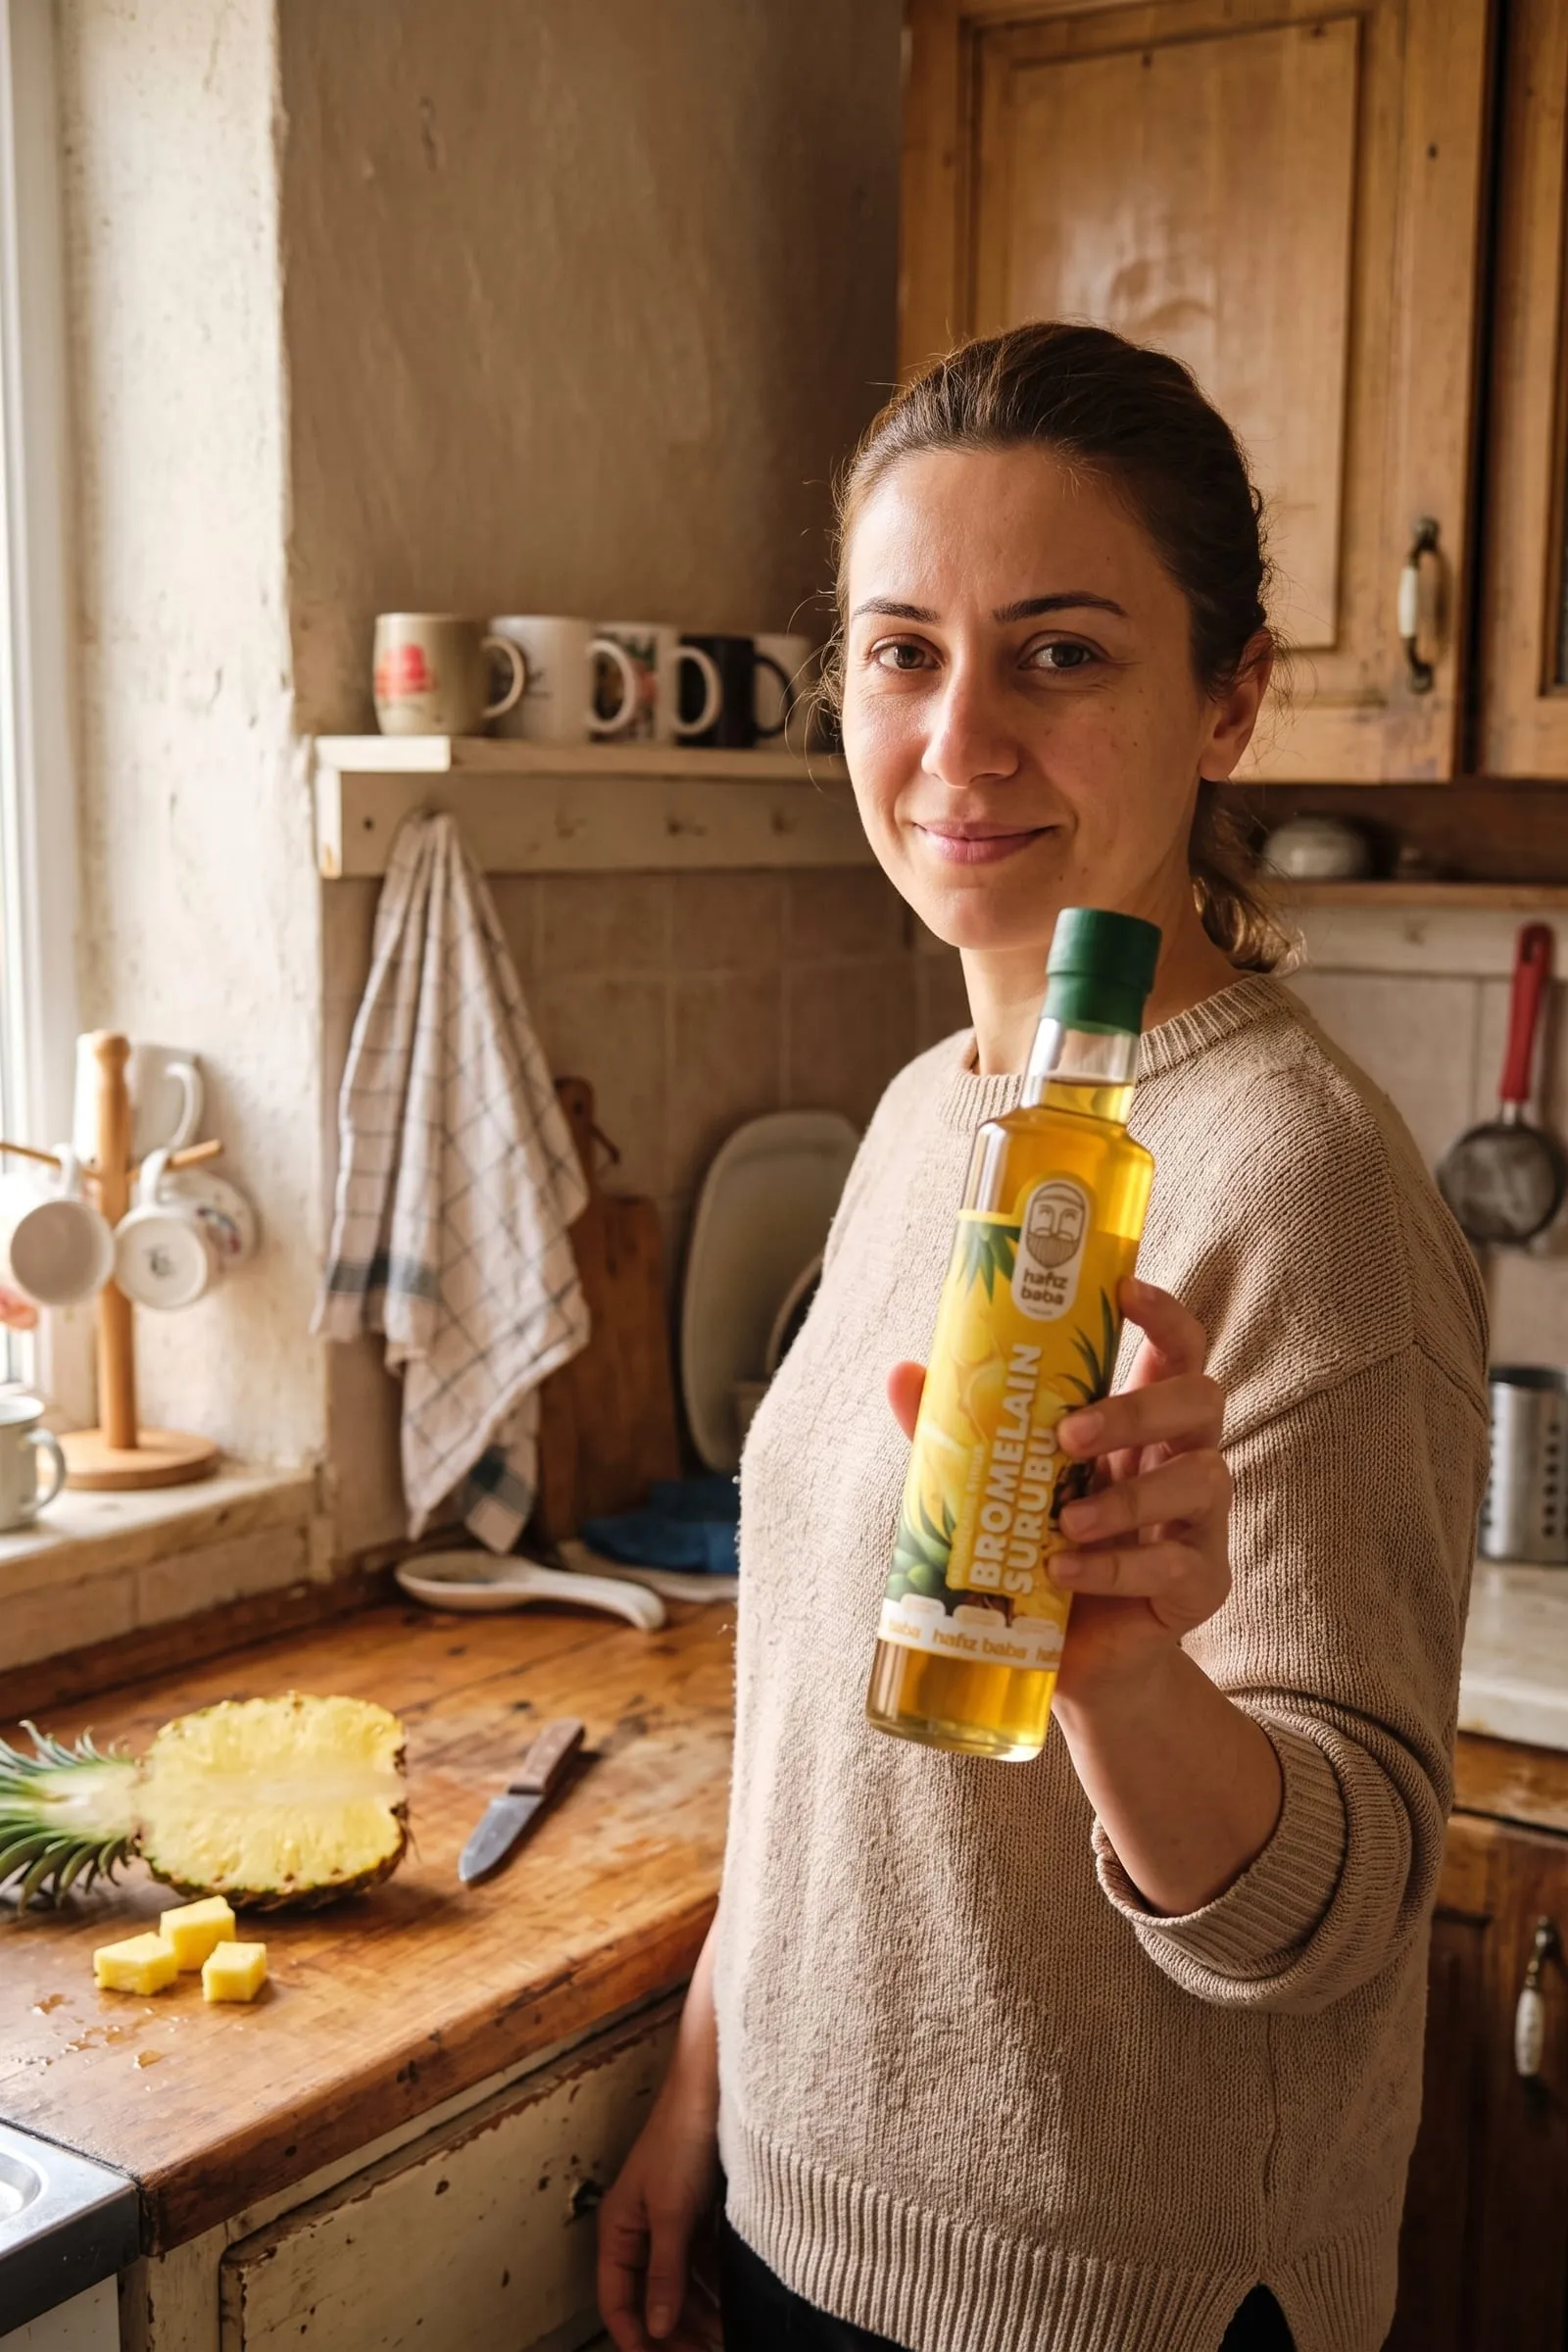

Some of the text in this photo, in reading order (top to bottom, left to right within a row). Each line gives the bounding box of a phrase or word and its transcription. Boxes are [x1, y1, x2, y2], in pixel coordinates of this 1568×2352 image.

[1021, 1285, 1065, 1306] baba
[969, 1343, 1042, 1588] BROMELAIN
[1004, 1427, 1057, 1595] SURUBU
[982, 1637, 1028, 1660] baba
